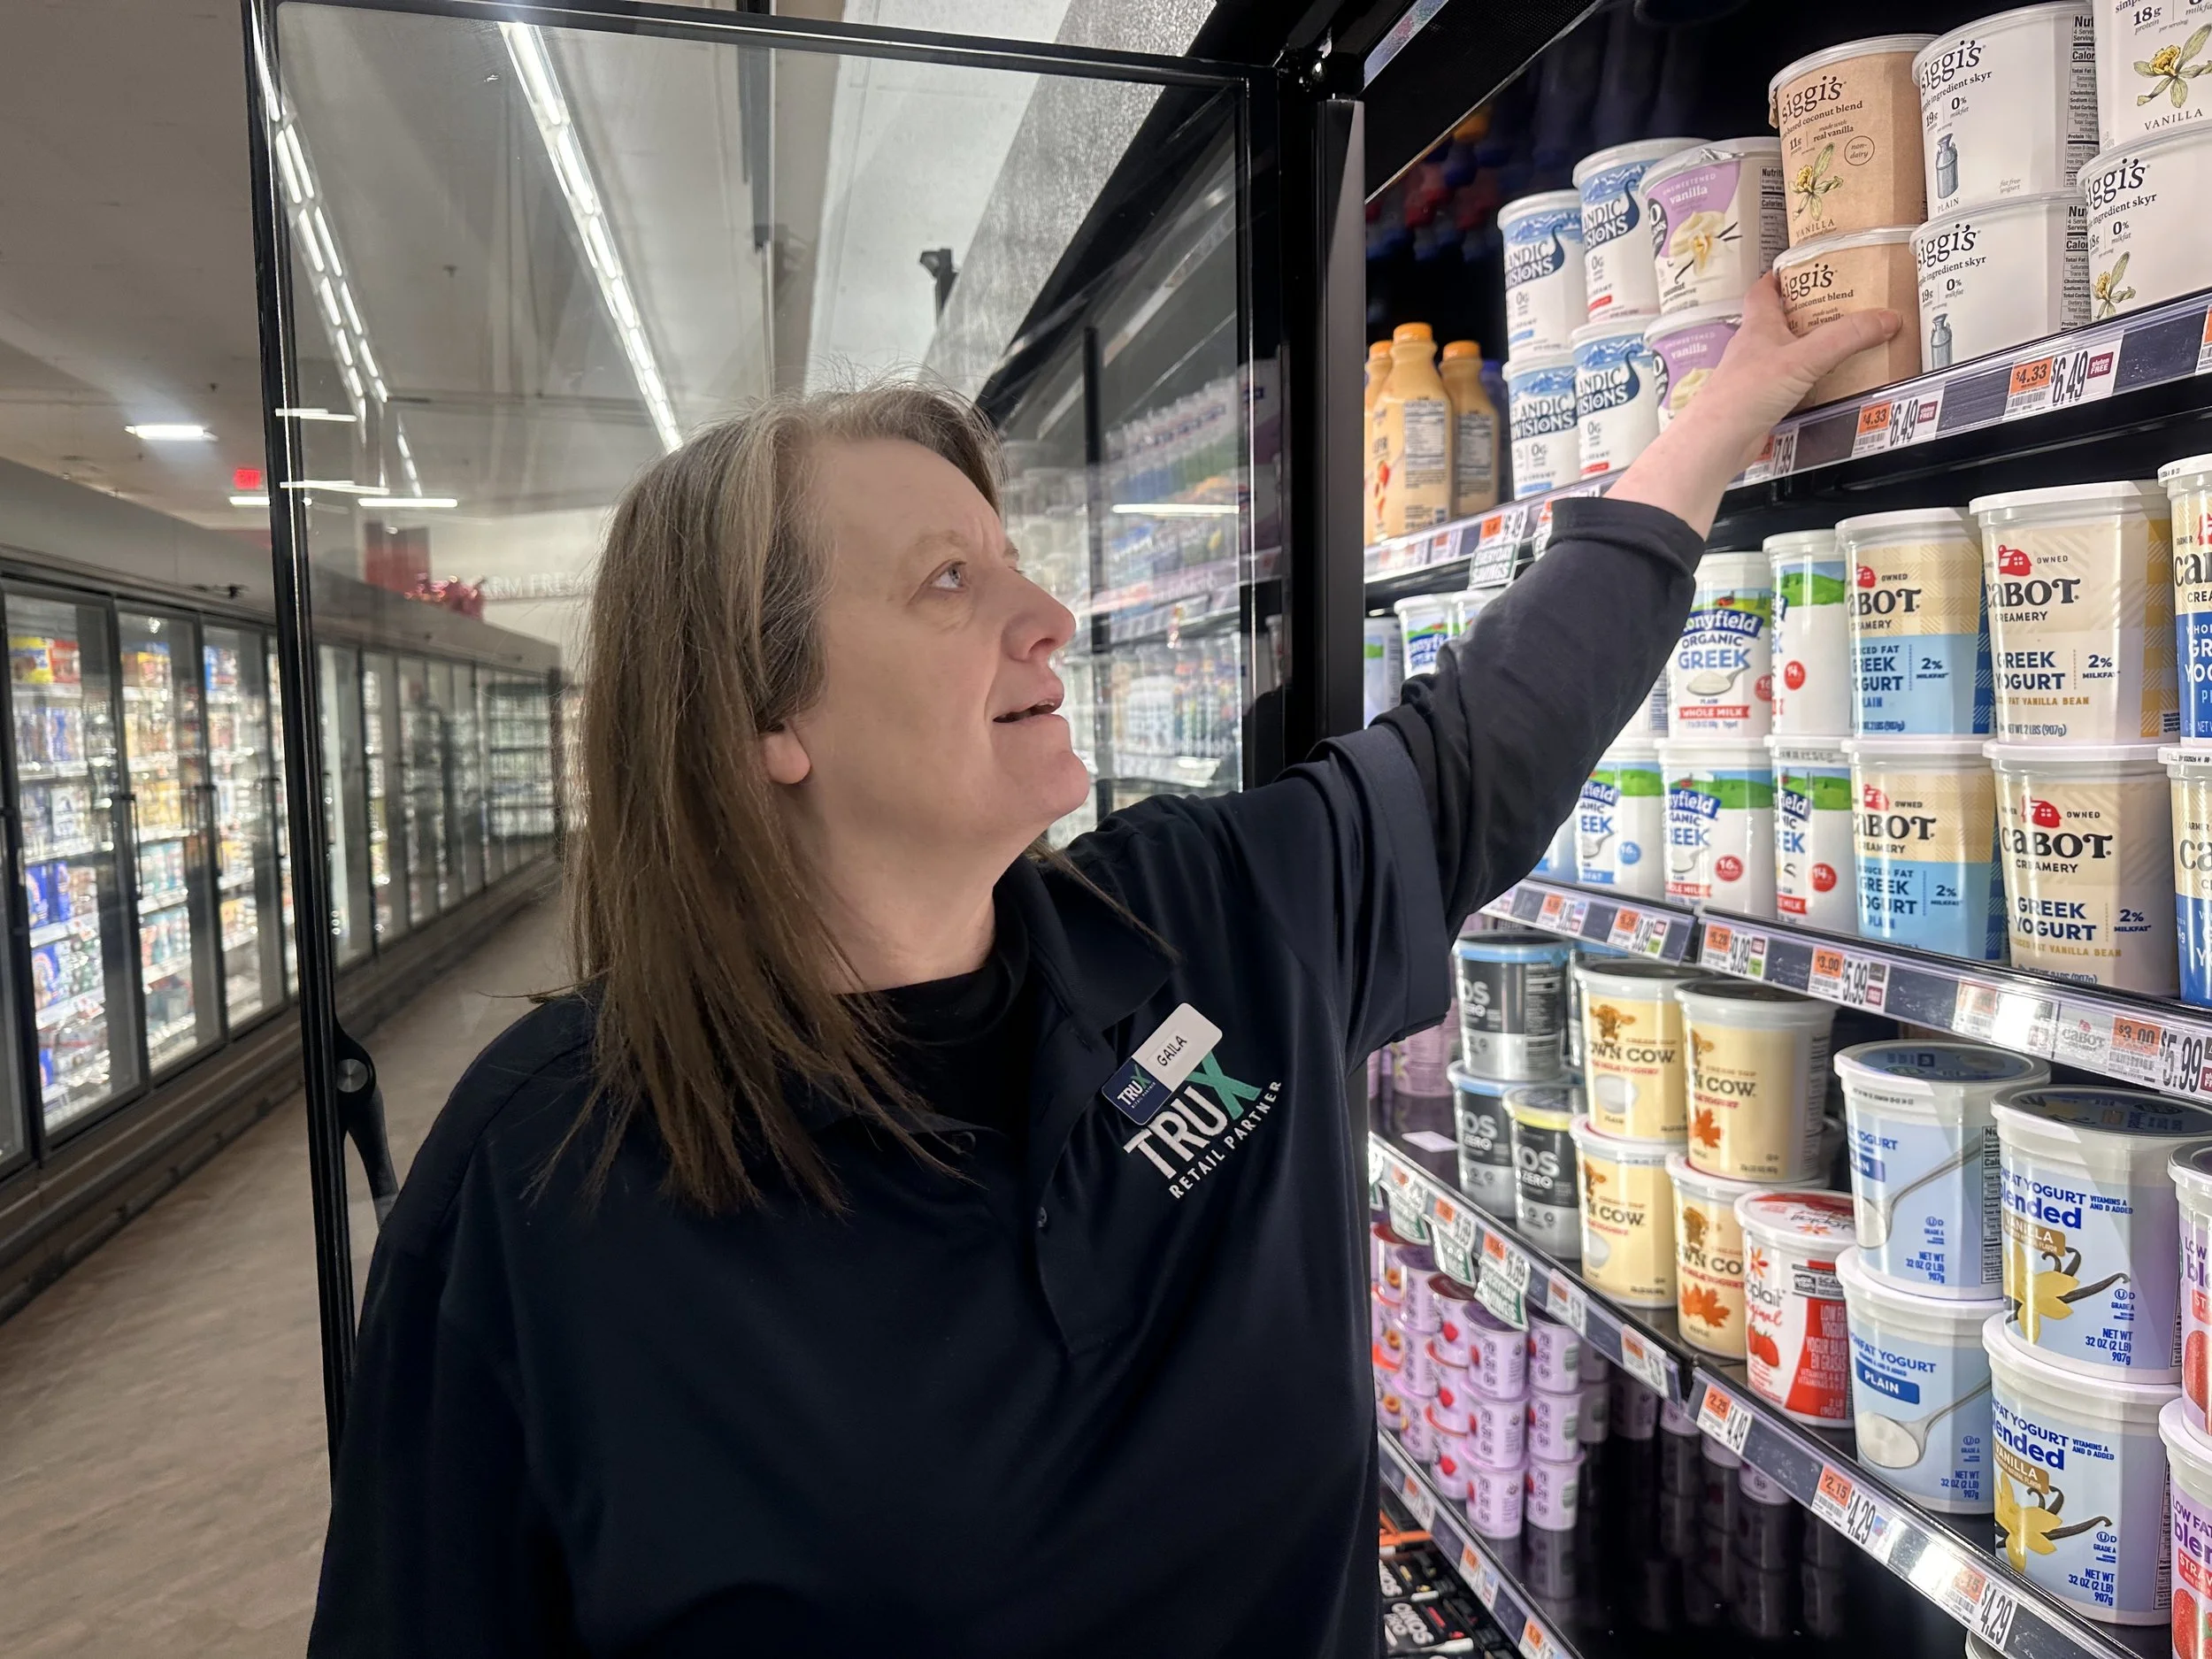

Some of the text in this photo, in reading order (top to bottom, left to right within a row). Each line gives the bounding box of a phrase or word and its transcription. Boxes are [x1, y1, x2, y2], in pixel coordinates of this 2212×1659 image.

[2133, 6, 2162, 26] 18g
[2134, 19, 2160, 35] protein
[1921, 40, 1981, 96] siggi's
[1931, 71, 1993, 104] ingredient skyr
[1781, 75, 1843, 125] siggi's
[1952, 96, 1967, 111] 0%
[1802, 100, 1863, 126] coconut blend
[2144, 108, 2203, 130] VANILLA
[1814, 126, 1854, 142] real vanilla
[1669, 185, 1709, 204] vanilla
[2086, 157, 2147, 214] iggi's
[1937, 197, 1960, 214] PLAIN
[2093, 193, 2157, 226] ingredient skyr
[1796, 219, 1835, 239] VANILLA
[2113, 221, 2130, 235] 0%
[1926, 256, 1986, 282] ingredient skyr
[1947, 278, 1962, 291] 0%
[1827, 289, 1855, 301] blend
[1671, 342, 1709, 359] vanilla
[2090, 363, 2109, 374] FREE
[2092, 358, 2110, 367] gluten
[2016, 364, 2047, 384] $4.33
[2051, 350, 2088, 407] $6.49
[1863, 408, 1887, 426] $4.33
[1889, 399, 1919, 448] $6.49
[1919, 411, 1934, 420] FREE
[2037, 555, 2069, 565] OWNED
[1882, 573, 1909, 582] OWNED
[1682, 610, 1759, 634] onyfield
[1682, 634, 1744, 649] ORGANIC
[1881, 645, 1900, 655] FAT
[1678, 649, 1751, 669] GREEK
[1922, 657, 1943, 671] 2%
[1997, 651, 2056, 669] GREEK
[2088, 654, 2113, 668] 2%
[1995, 672, 2066, 690] YOGURT
[2022, 697, 2057, 706] VANILLA
[2062, 696, 2090, 705] BEAN
[1682, 708, 1743, 718] WHOLE MILK
[2030, 724, 2067, 737] LBS (907g)
[1893, 869, 1914, 879] FAT
[2016, 859, 2078, 873] CREAMERY
[1936, 885, 1956, 897] 2%
[2017, 896, 2086, 919] GREEK
[2120, 909, 2144, 922] 2%
[2014, 916, 2096, 941] YOGURT
[2050, 944, 2122, 957] VANILLA BEAN
[1817, 955, 1839, 972] $3.00
[1842, 958, 1869, 1005] $5.99
[2118, 1024, 2155, 1044] $3.00
[1157, 1035, 1187, 1067] GAILA
[1626, 1048, 1675, 1064] COW
[2160, 1028, 2203, 1093] $5.99
[1118, 1064, 1151, 1106] TRUX
[1706, 1076, 1755, 1097] COW
[1123, 1050, 1263, 1180] TRUX
[1169, 1081, 1282, 1200] RETAIL PARTNER
[1522, 1170, 1554, 1190] ZERO
[2024, 1178, 2086, 1204] YOGURT
[2090, 1195, 2120, 1205] VITAMINS
[1599, 1205, 1644, 1225] COW
[2111, 1206, 2133, 1215] ADDED
[2006, 1215, 2054, 1244] VANILLA
[1906, 1257, 1945, 1274] 32 OZ LB)
[1919, 1251, 1945, 1263] NET WT
[1928, 1271, 1945, 1284] 907g
[2111, 1302, 2129, 1310] GRADE
[2102, 1327, 2132, 1341] NET WT
[2085, 1335, 2131, 1353] 32 OZ (2 LB)
[1878, 1349, 1936, 1373] YOGURT
[2111, 1352, 2131, 1365] 907g
[1864, 1371, 1900, 1394] PLAIN
[2010, 1412, 2102, 1452] YOGURT VITAMINS
[1994, 1441, 2038, 1481] VANILLA
[2072, 1446, 2115, 1461] AND ADDED
[1955, 1470, 1979, 1480] NET WT
[1824, 1474, 1848, 1500] $2.15
[1940, 1479, 1979, 1490] 32 OZ (2 LB)
[1963, 1489, 1979, 1501] 907g
[1847, 1490, 1877, 1545] $4.29
[2172, 1495, 2191, 1523] LOW
[2093, 1544, 2109, 1553] GRADE
[2069, 1574, 2114, 1594] 32 OZ (2 LB)
[2085, 1568, 2115, 1583] NET WT
[2094, 1593, 2114, 1606] 907g
[1981, 1582, 2013, 1646] $4.29
